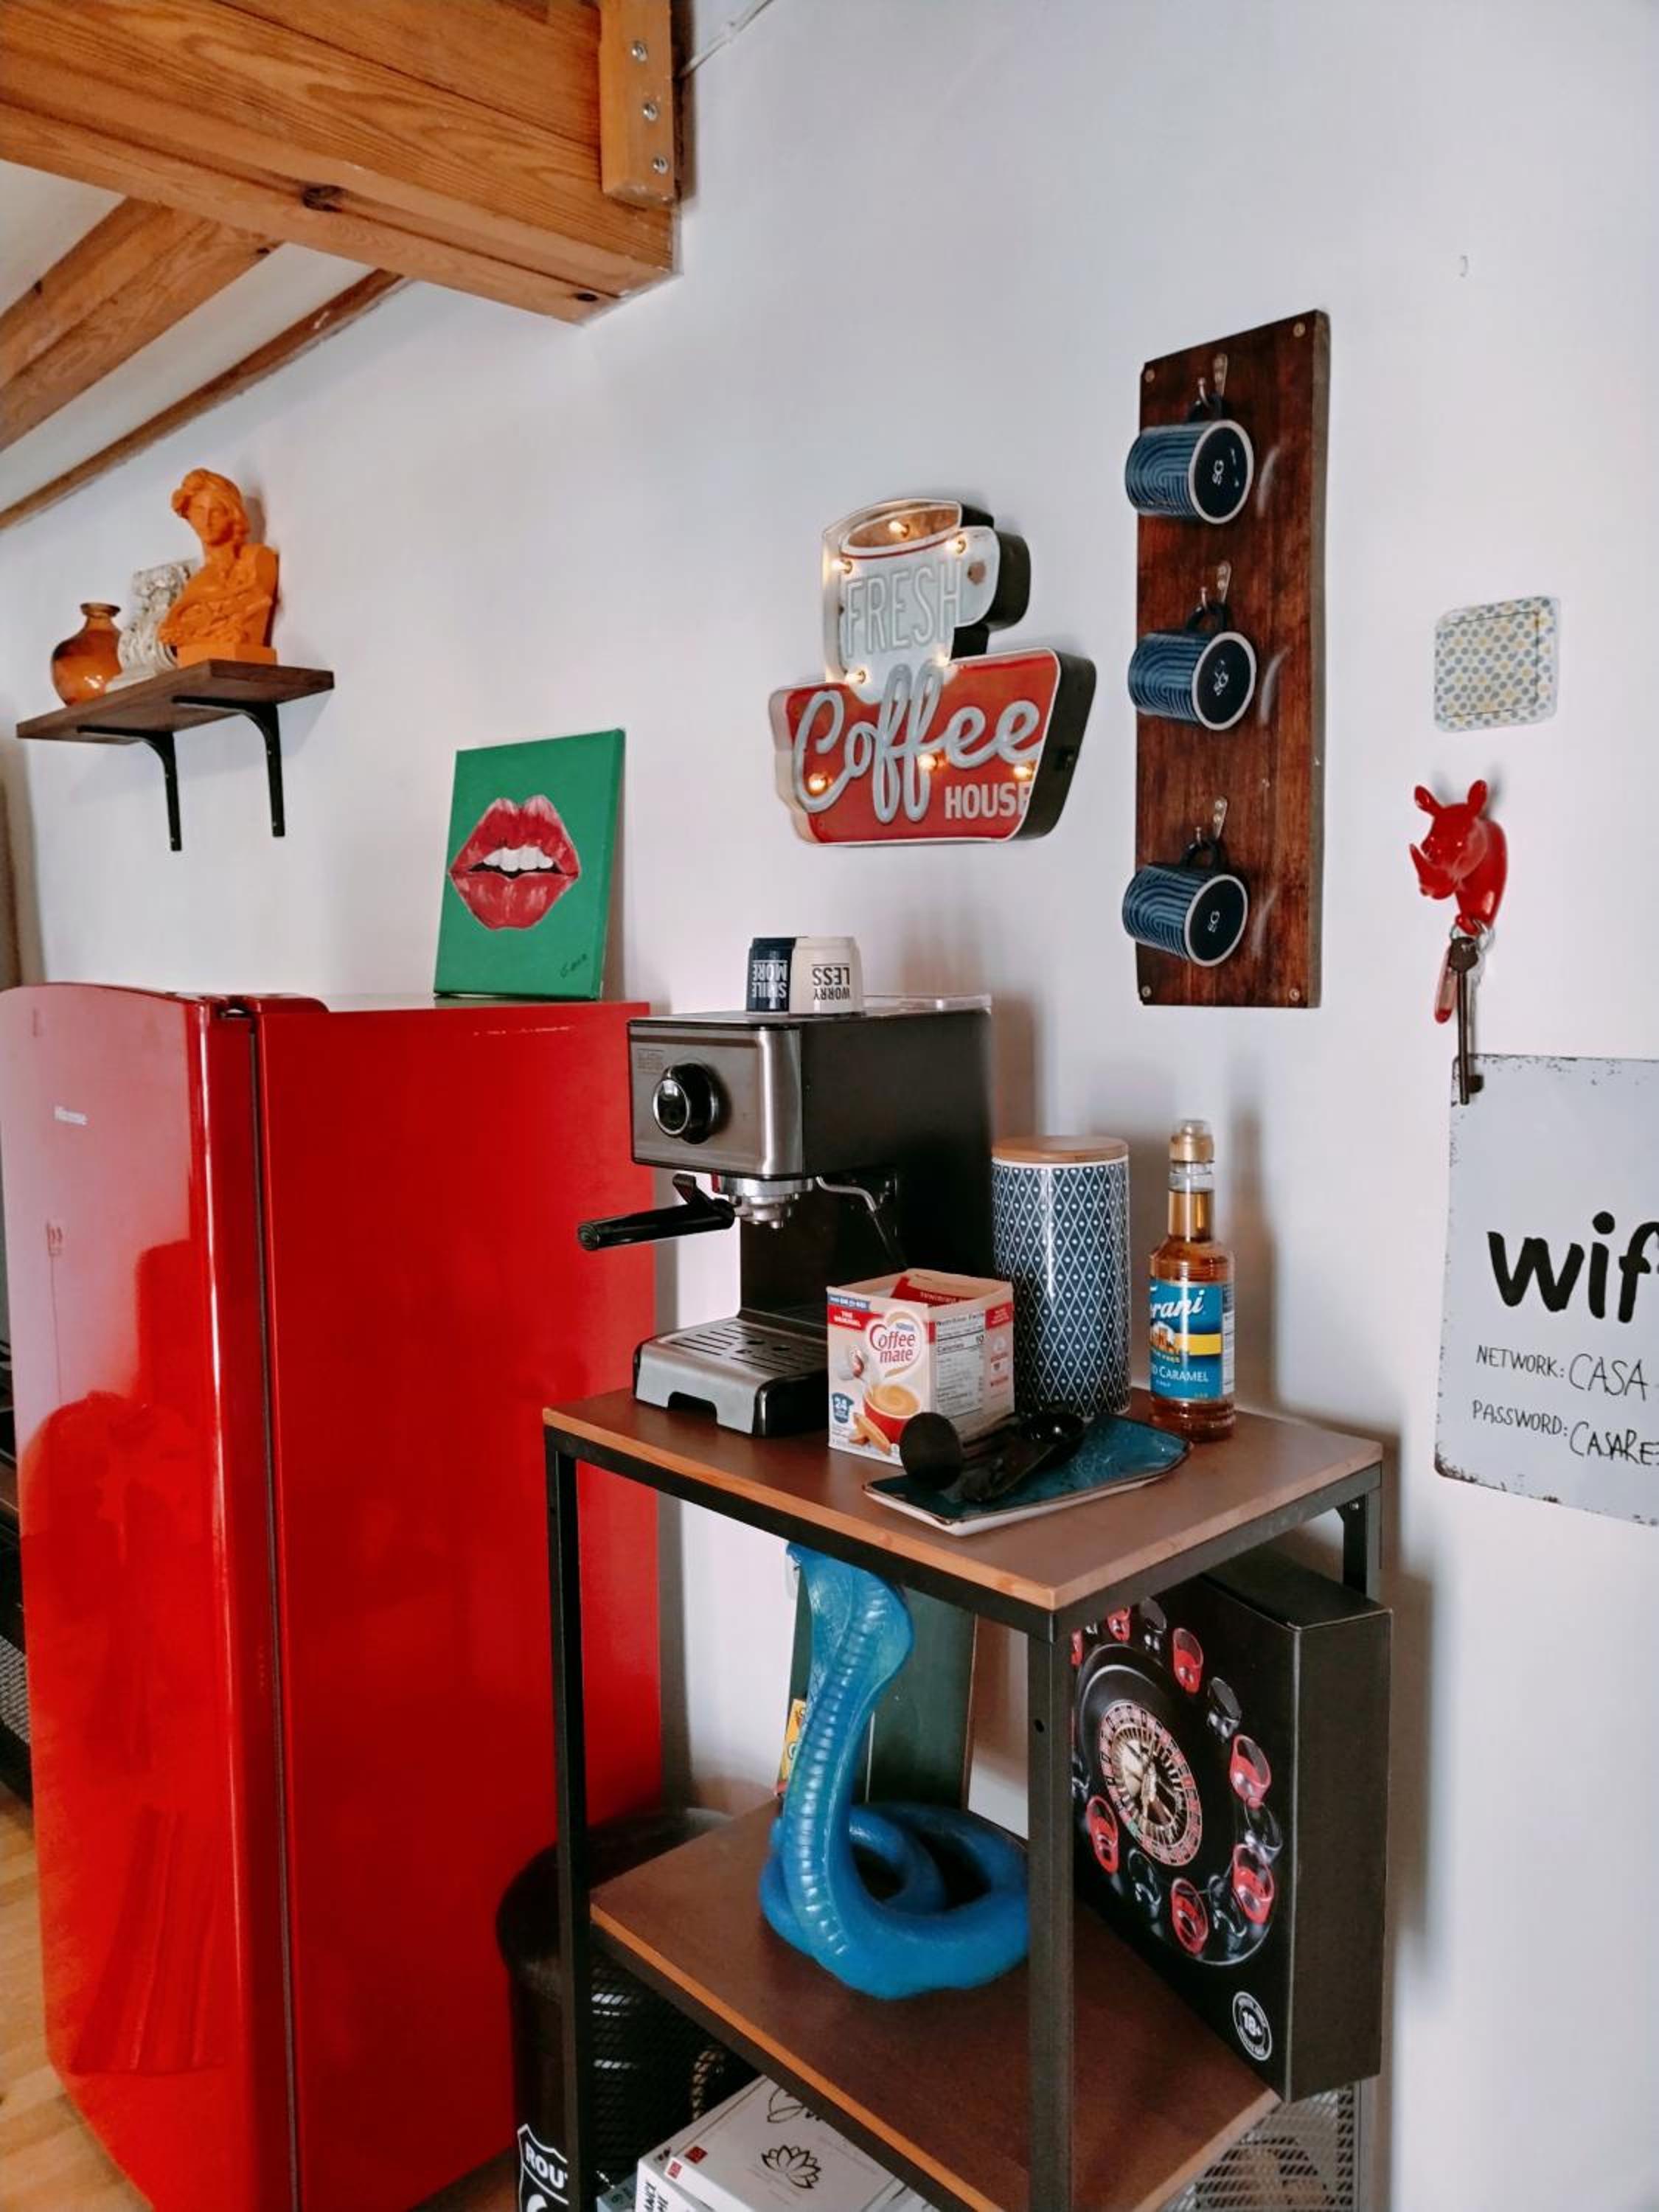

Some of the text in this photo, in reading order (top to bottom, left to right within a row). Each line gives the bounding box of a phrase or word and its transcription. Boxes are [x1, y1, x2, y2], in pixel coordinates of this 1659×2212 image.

[846, 562, 961, 658] FRESH
[792, 661, 1041, 823] Coffee
[753, 963, 787, 981] MORE
[813, 967, 850, 986] LESS
[752, 982, 787, 998] SMILE
[813, 987, 850, 1001] WORRY
[869, 1324, 916, 1351] Coffee
[880, 1348, 914, 1363] mate
[1158, 1366, 1208, 1382] CARAMEL
[1476, 1345, 1649, 1402] NETWORK: CASA
[1472, 1400, 1568, 1437] PASSWORD:
[525, 2142, 568, 2189] ROU
